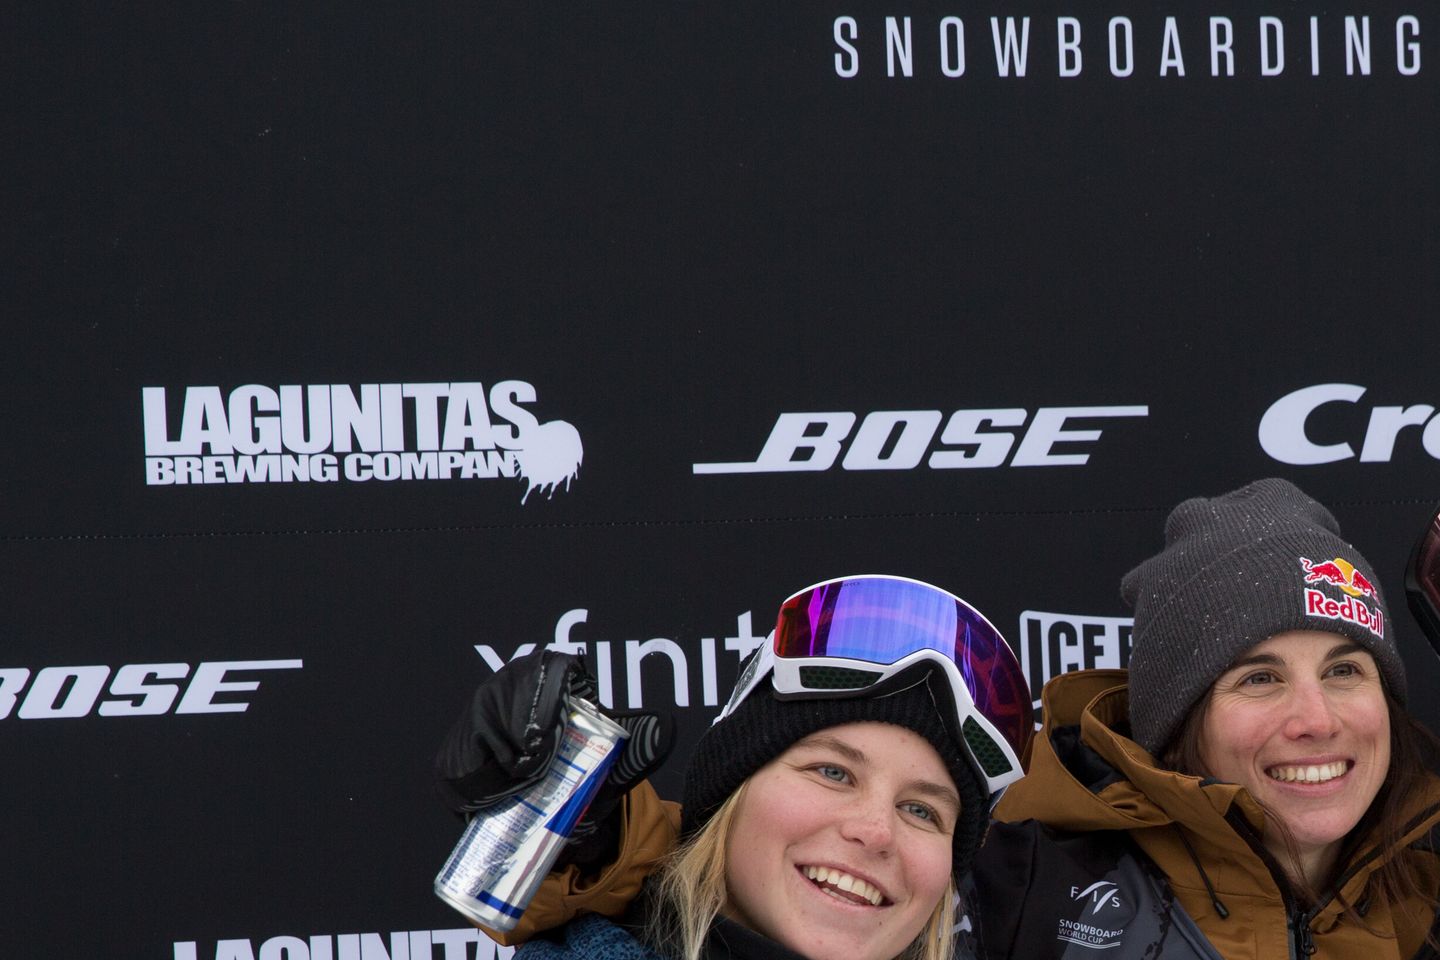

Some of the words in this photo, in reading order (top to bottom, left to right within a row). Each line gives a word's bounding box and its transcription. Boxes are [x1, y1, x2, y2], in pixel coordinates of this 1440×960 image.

[832, 15, 1421, 78] SNOWBOARDING
[142, 379, 541, 456] LAGUNITAS
[692, 405, 1149, 475] BOSE
[145, 454, 339, 486] BREWING
[1304, 588, 1355, 621] Red
[1353, 598, 1384, 640] Bull
[1058, 927, 1087, 941] WORLD
[1087, 935, 1104, 944] CUP
[1059, 918, 1123, 939] SNOWBOARD
